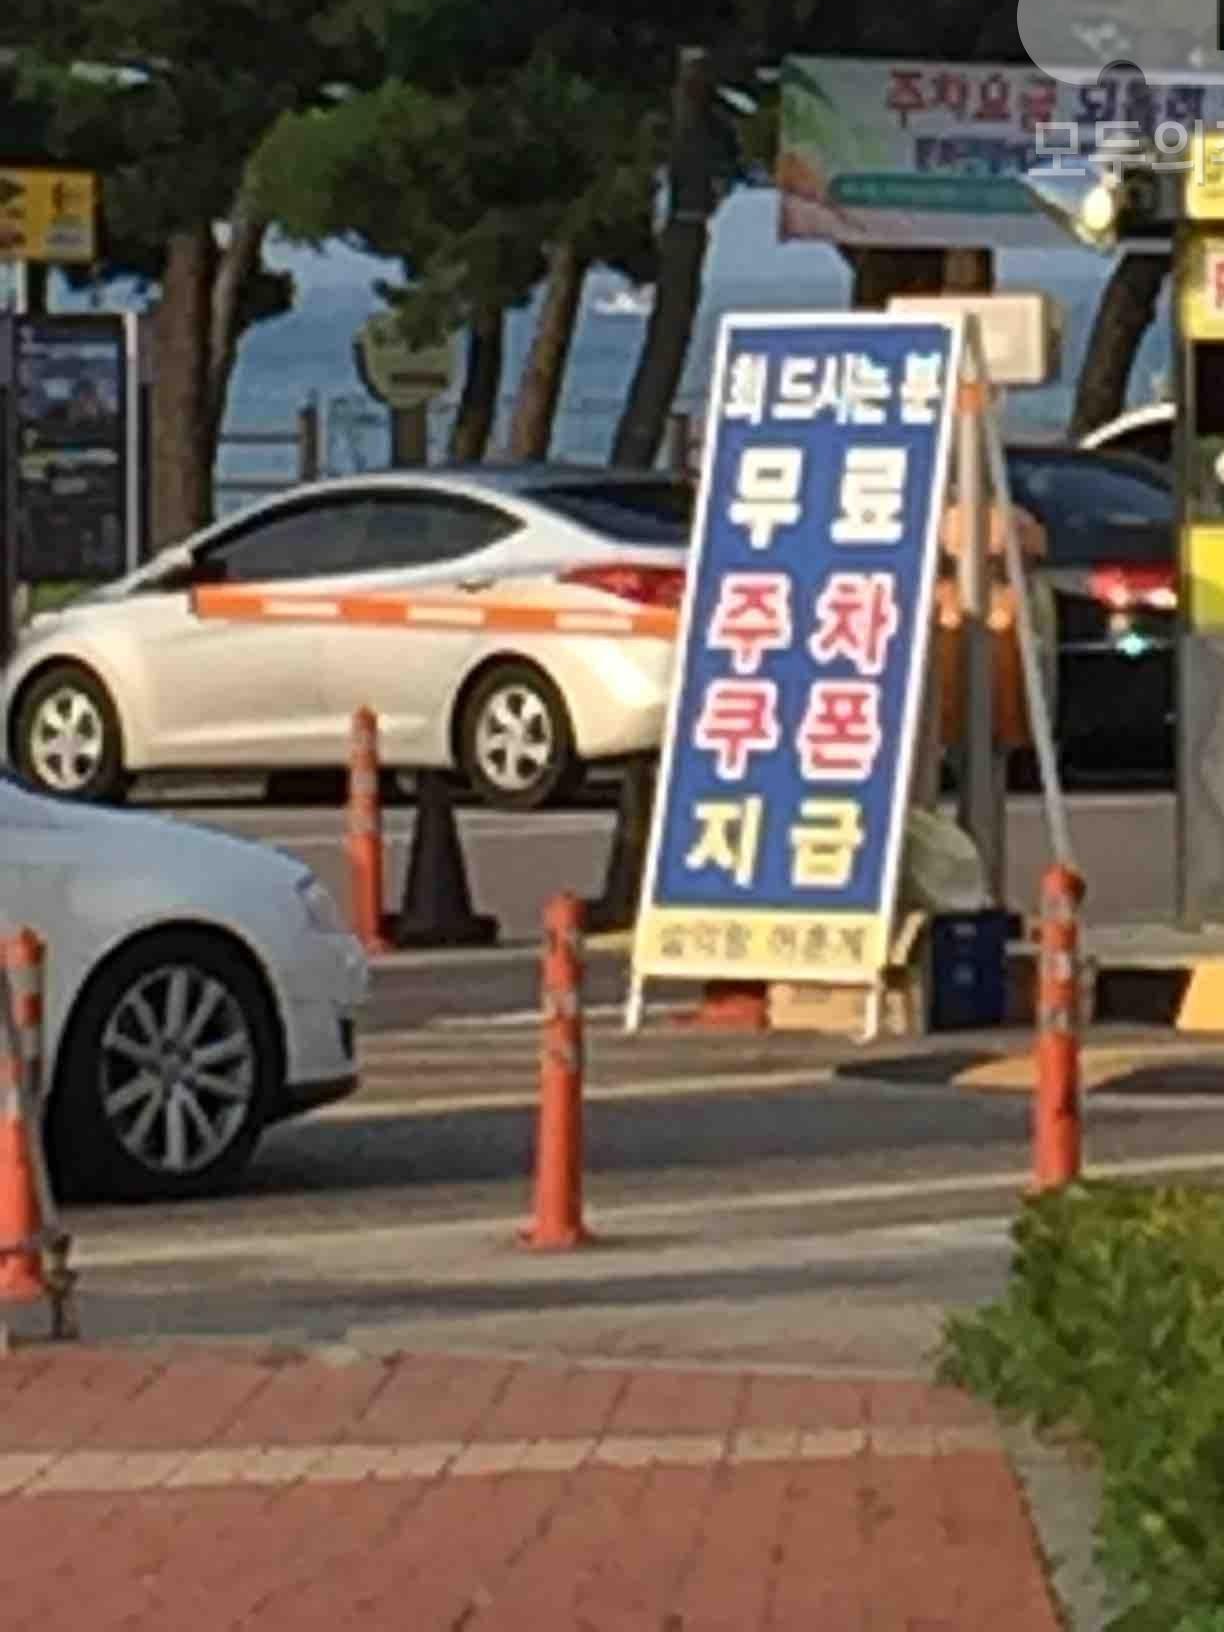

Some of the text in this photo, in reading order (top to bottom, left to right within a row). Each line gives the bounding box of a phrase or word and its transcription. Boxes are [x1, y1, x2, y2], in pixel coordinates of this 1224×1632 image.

[727, 446, 908, 549] 무료
[706, 572, 898, 671] 주차
[695, 679, 880, 780] 쿠폰
[686, 796, 866, 888] 지급
